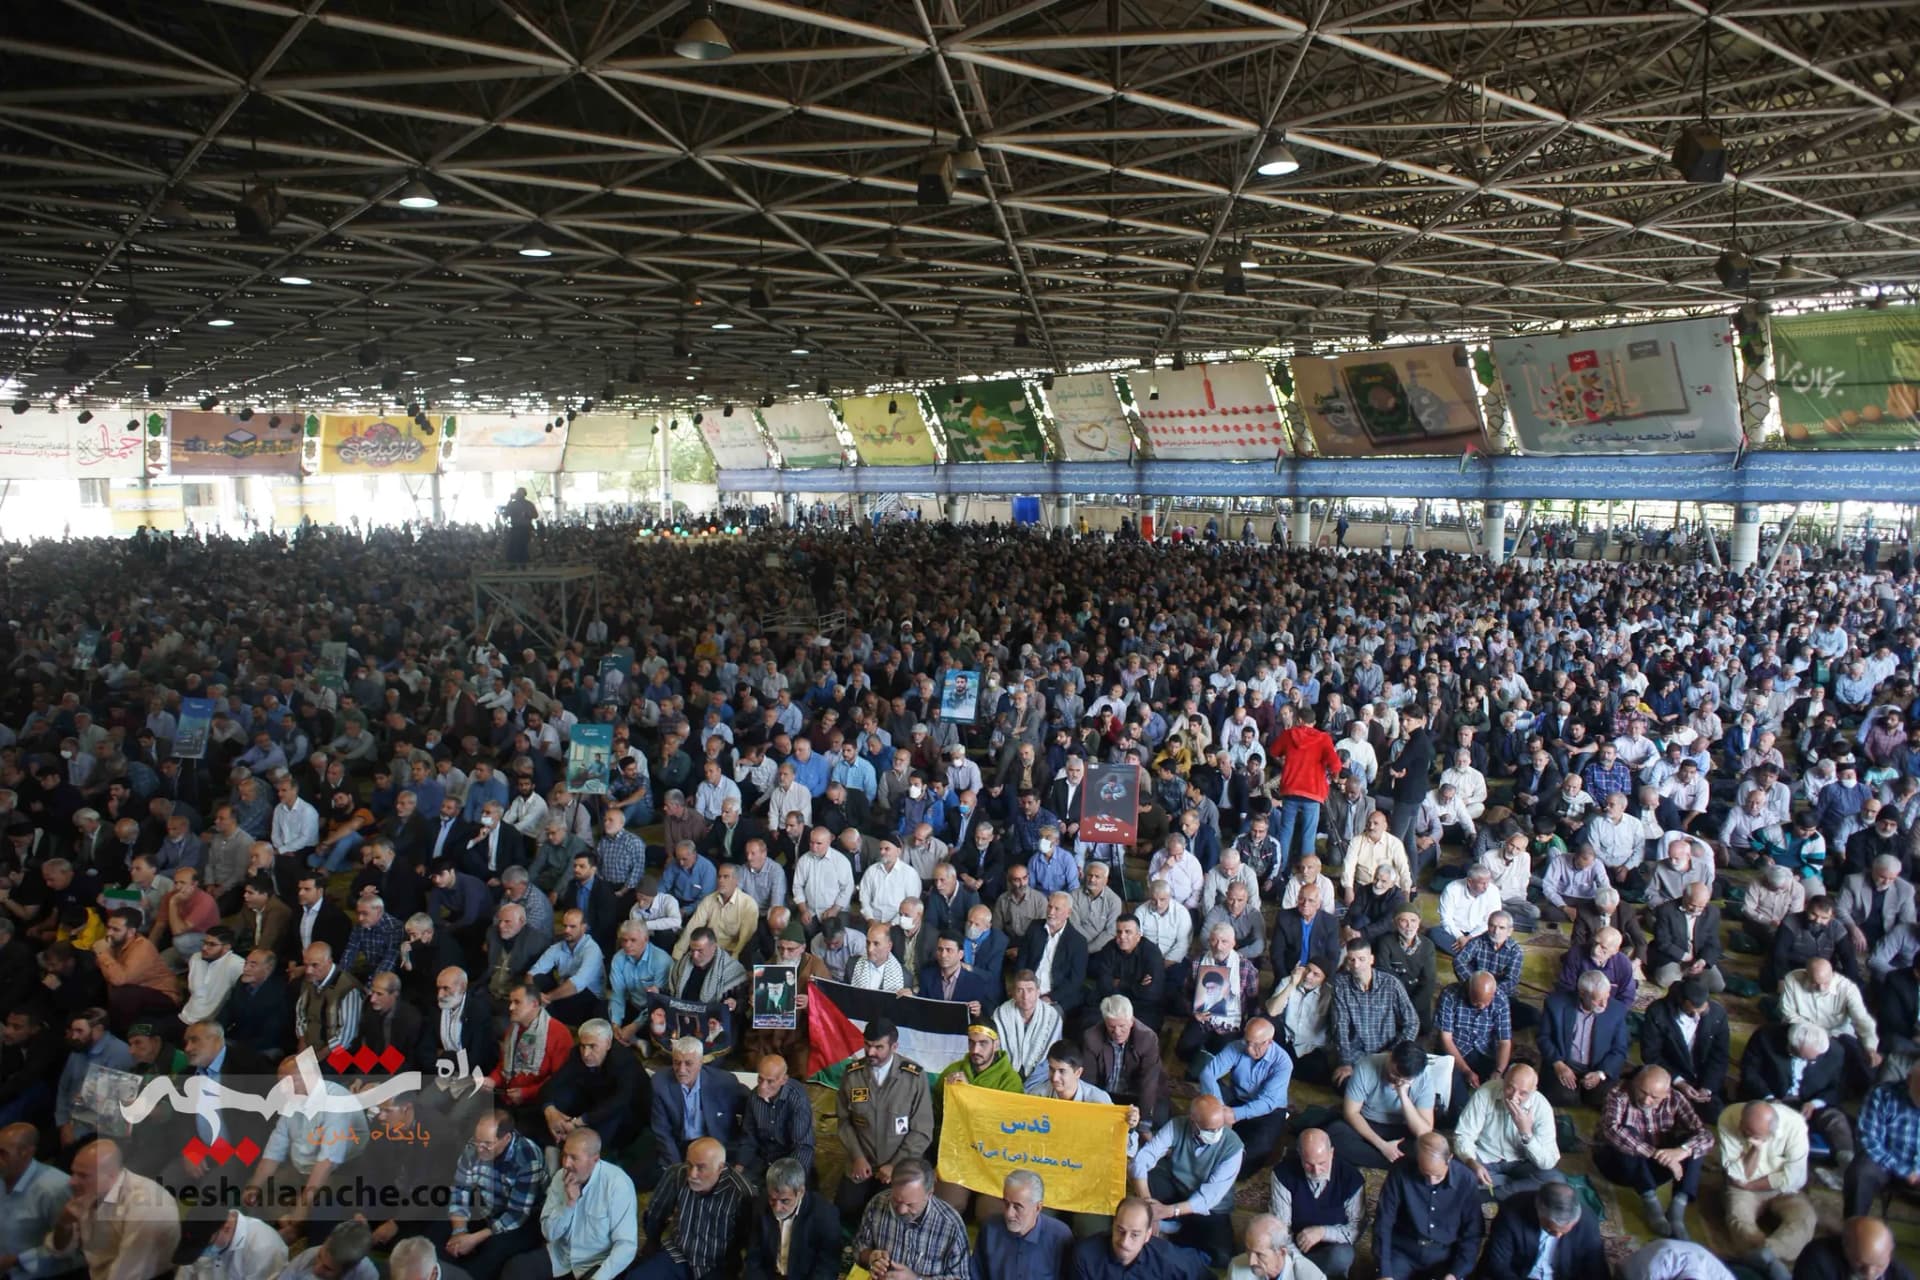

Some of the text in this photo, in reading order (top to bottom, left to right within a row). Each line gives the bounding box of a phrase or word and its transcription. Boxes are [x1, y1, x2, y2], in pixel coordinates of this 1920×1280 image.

[1780, 353, 1846, 398] بخوان مرا
[1000, 1115, 1051, 1134] قدس
[1002, 1147, 1028, 1164] (ص)
[1031, 1156, 1058, 1166] محمد
[1061, 1158, 1083, 1172] سپاه
